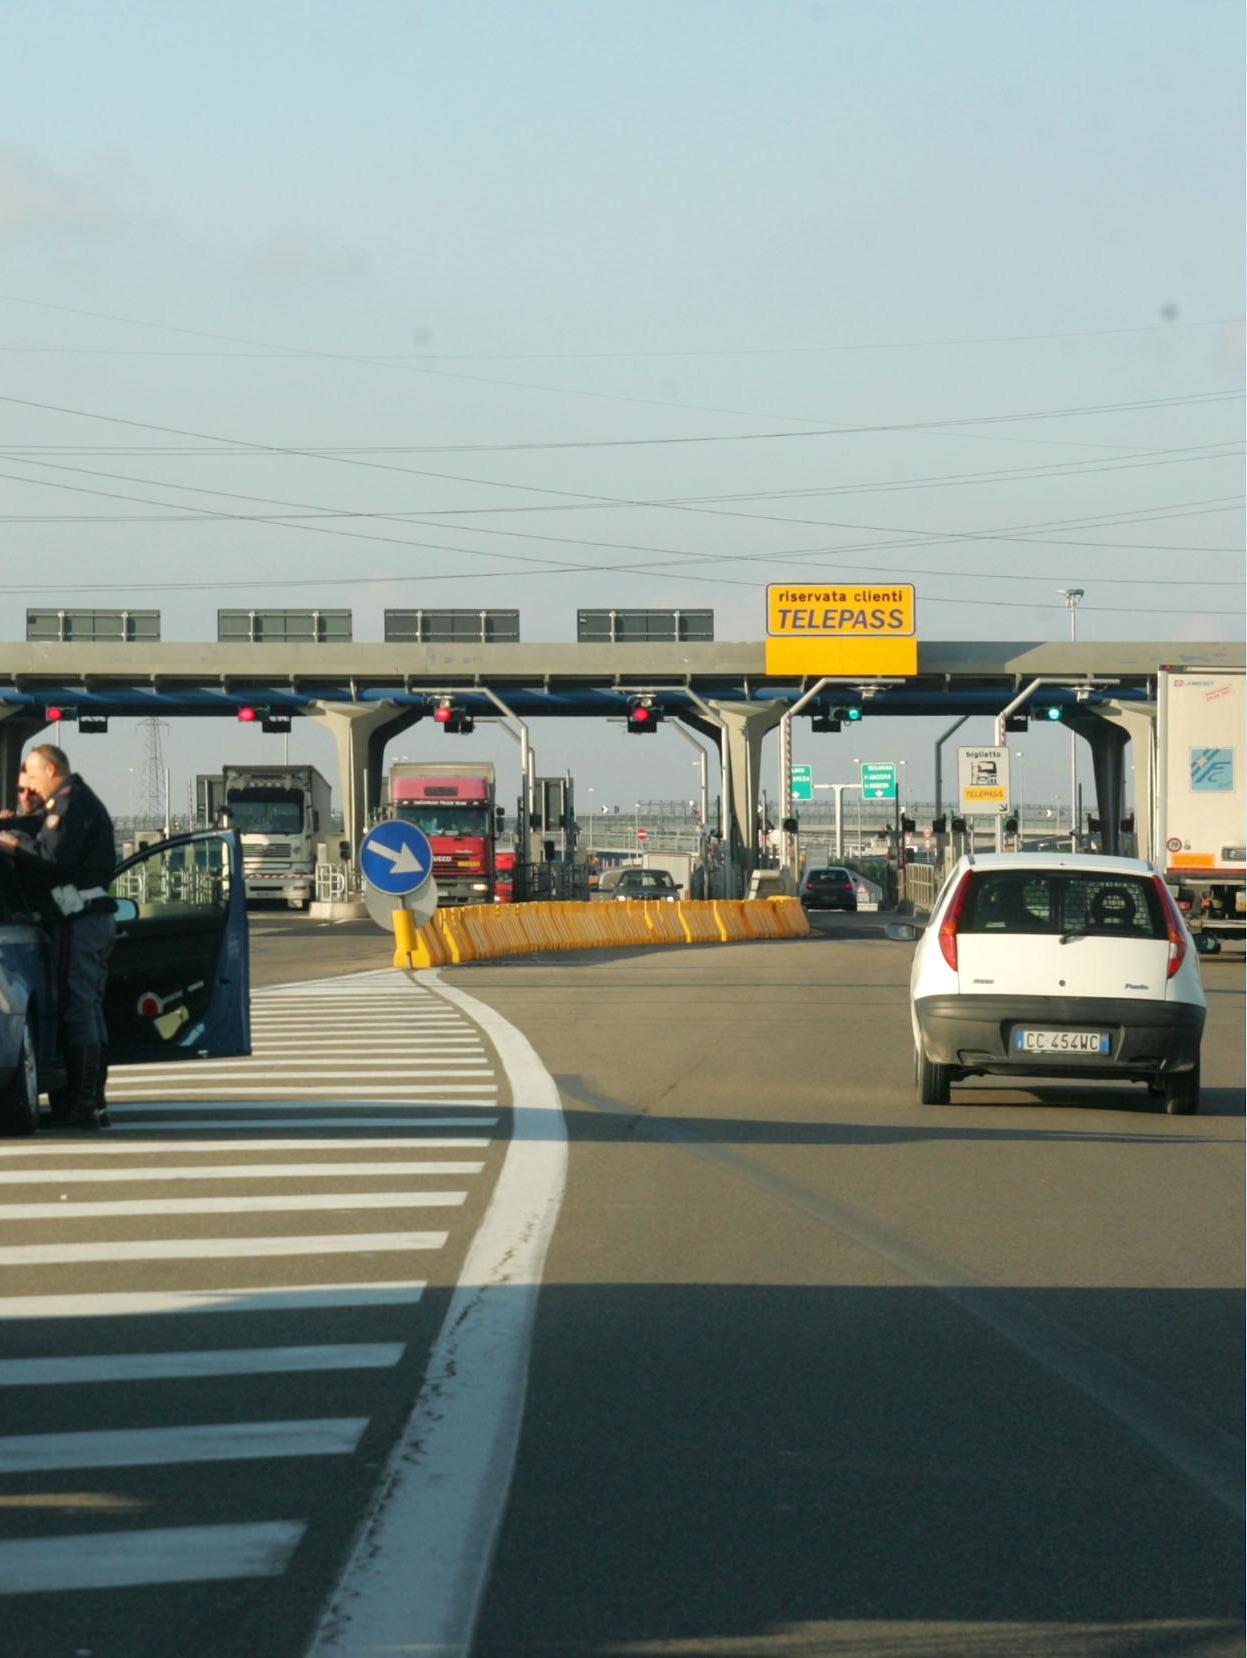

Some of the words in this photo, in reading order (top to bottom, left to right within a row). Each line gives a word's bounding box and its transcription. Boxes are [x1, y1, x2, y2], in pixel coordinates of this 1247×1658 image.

[778, 590, 847, 602] riservata
[853, 590, 903, 602] clienti
[778, 609, 904, 629] TELEPASS
[966, 751, 1001, 759] biglietto
[966, 790, 1003, 798] TELEPASS
[1026, 1033, 1046, 1048] CC
[1051, 1034, 1098, 1050] 454WC
